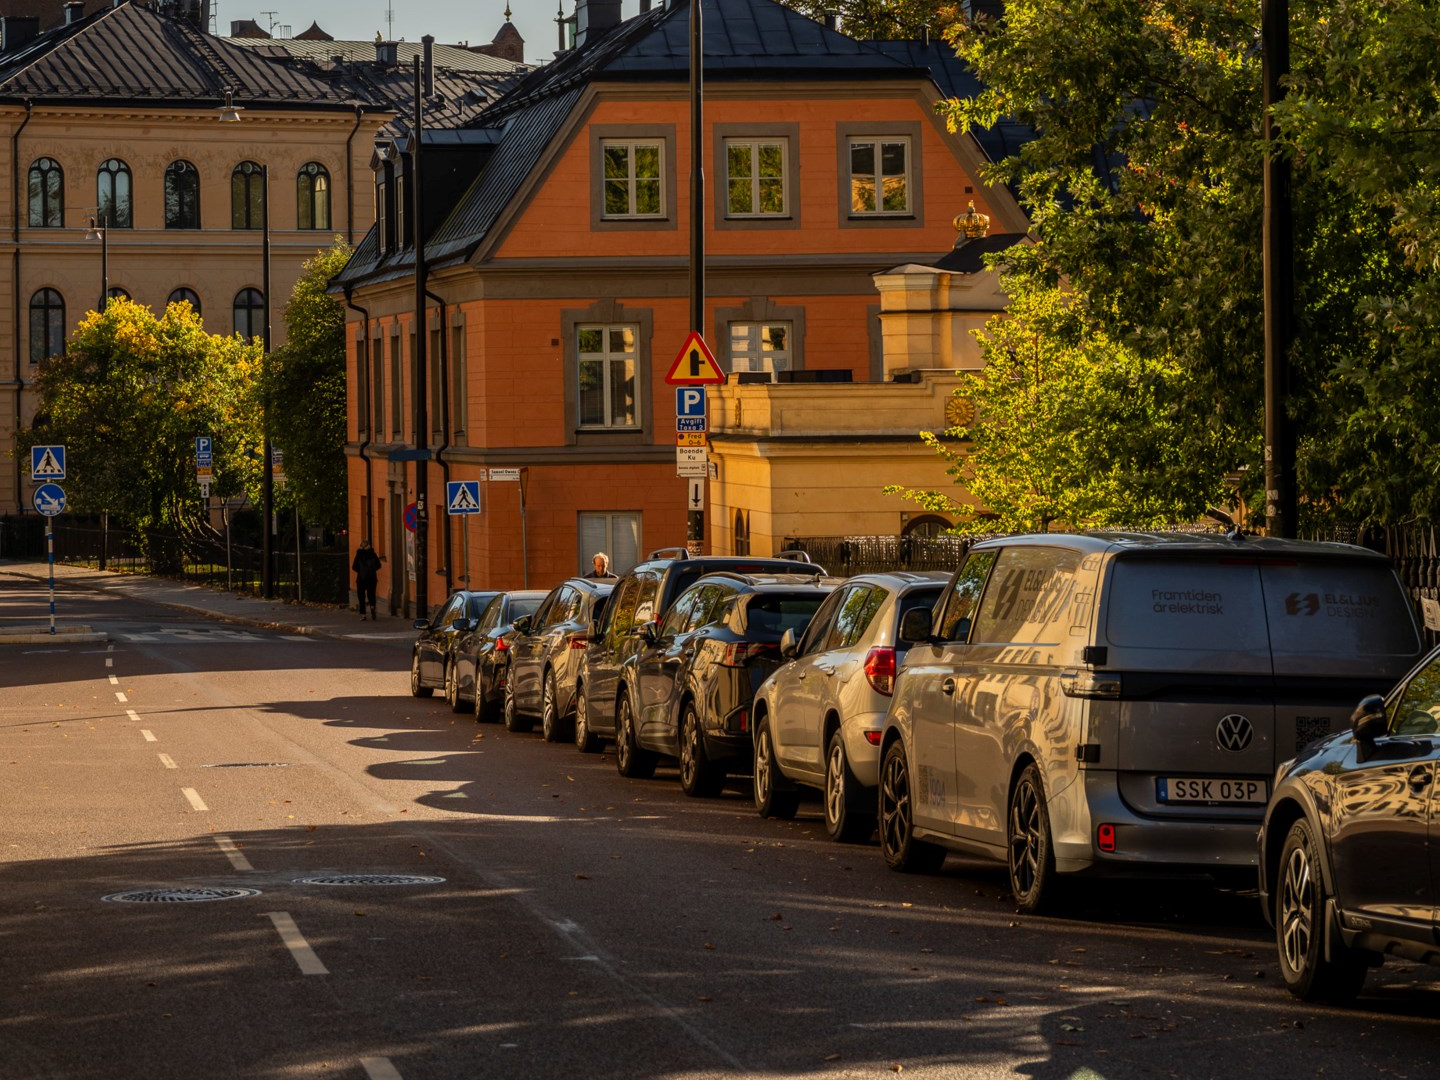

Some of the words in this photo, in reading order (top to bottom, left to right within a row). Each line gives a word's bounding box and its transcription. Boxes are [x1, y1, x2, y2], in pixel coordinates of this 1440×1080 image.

[684, 390, 701, 414] P
[199, 438, 209, 451] P
[1151, 589, 1222, 602] Framtiden
[1325, 593, 1380, 607] EL&LJUS
[1326, 606, 1376, 618] DESIGN
[1175, 780, 1213, 799] SSK
[1220, 781, 1258, 801] 03P
